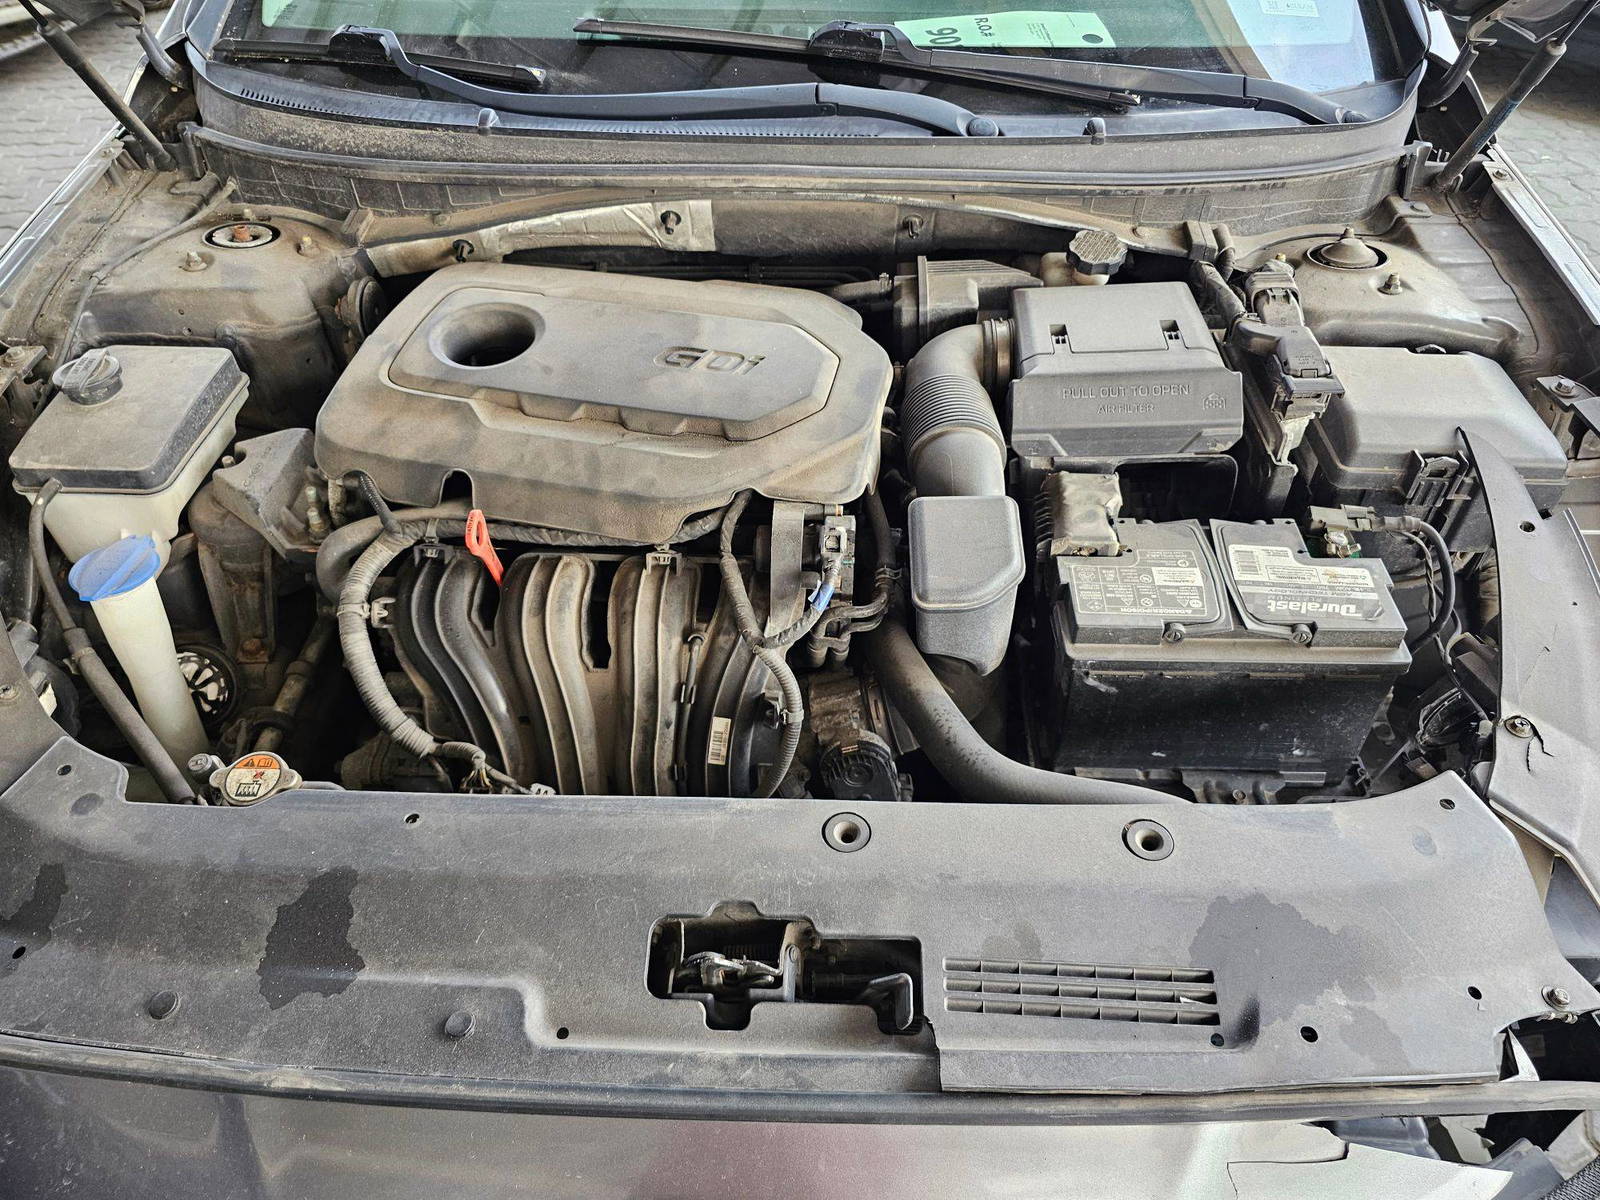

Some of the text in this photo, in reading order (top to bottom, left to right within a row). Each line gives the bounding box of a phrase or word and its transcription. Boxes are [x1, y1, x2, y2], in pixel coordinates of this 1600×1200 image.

[974, 17, 994, 37] R.O.#
[925, 27, 964, 48] 90
[1062, 384, 1190, 400] PULL OUT TO OPEN
[1097, 404, 1155, 415] AIR FILTER
[1267, 600, 1363, 617] Duralast
